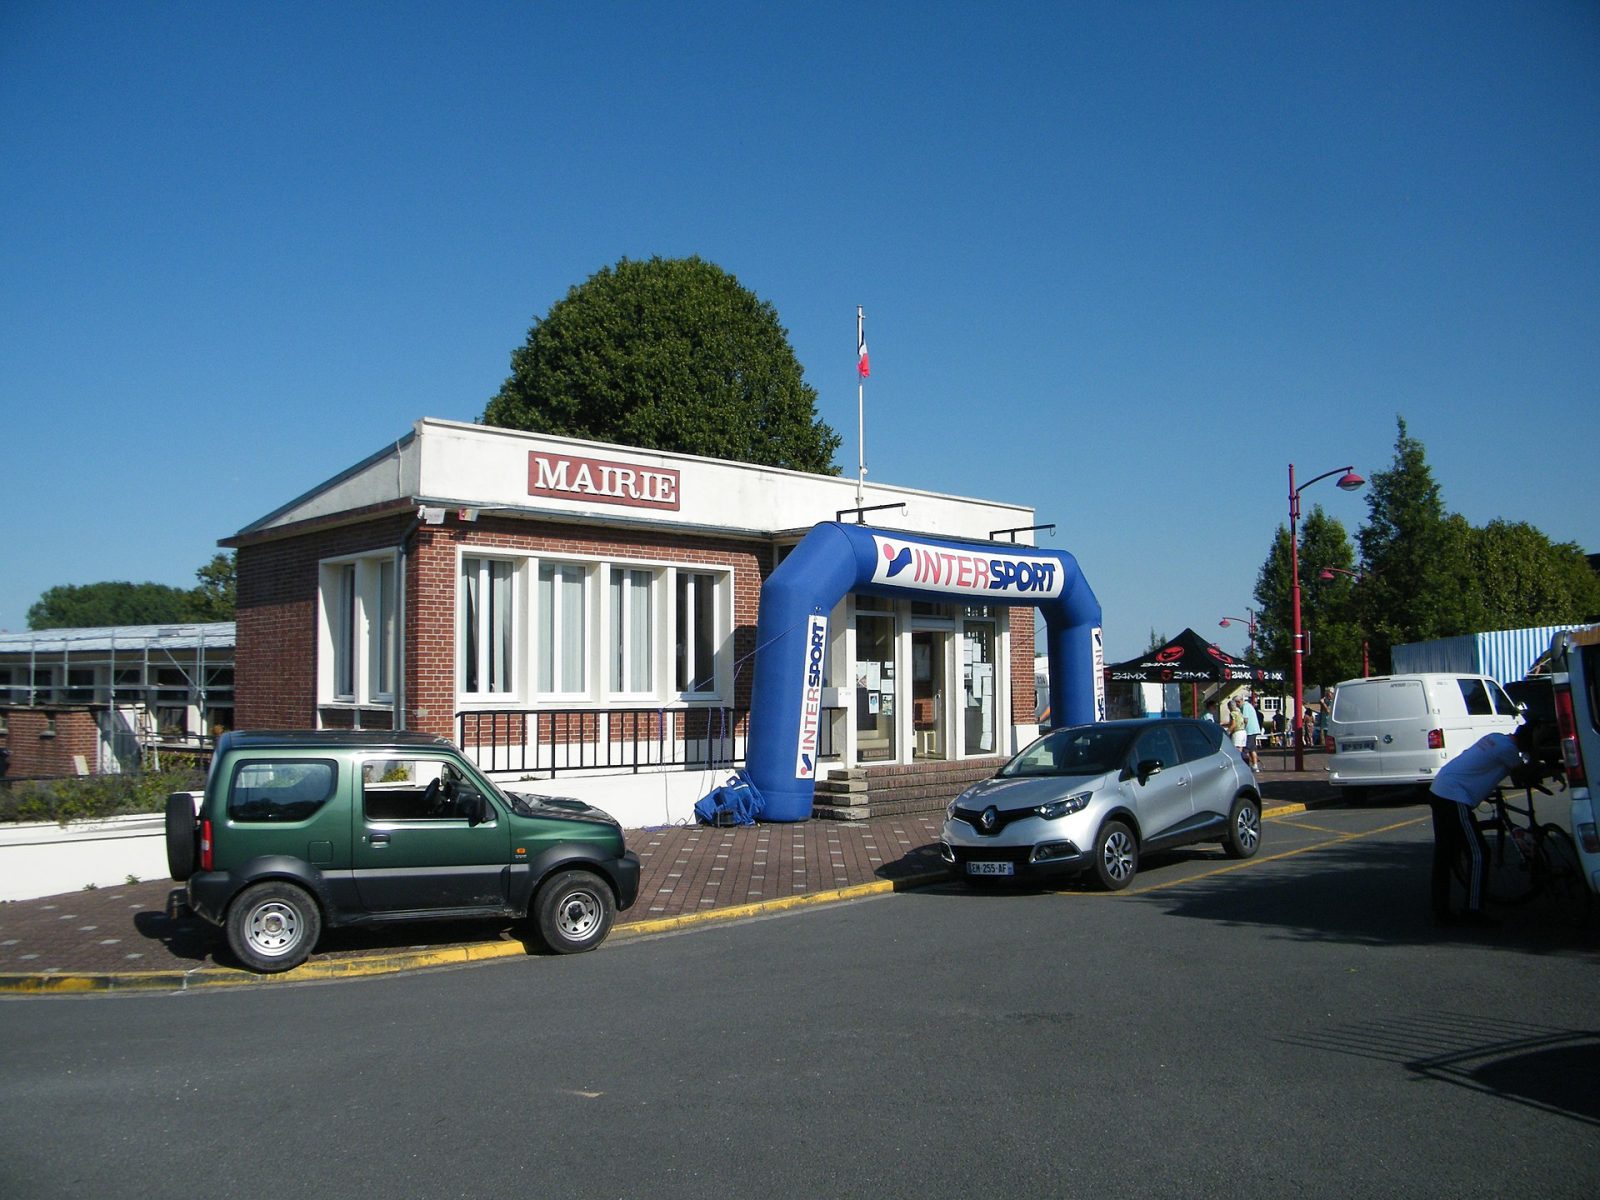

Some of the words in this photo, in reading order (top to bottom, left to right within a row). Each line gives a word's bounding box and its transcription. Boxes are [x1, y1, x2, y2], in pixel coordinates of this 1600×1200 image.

[535, 458, 676, 503] MAIRIE
[914, 548, 1056, 592] INTERSPORT
[803, 622, 824, 750] INTERSPORT
[1231, 671, 1252, 680] 24MX
